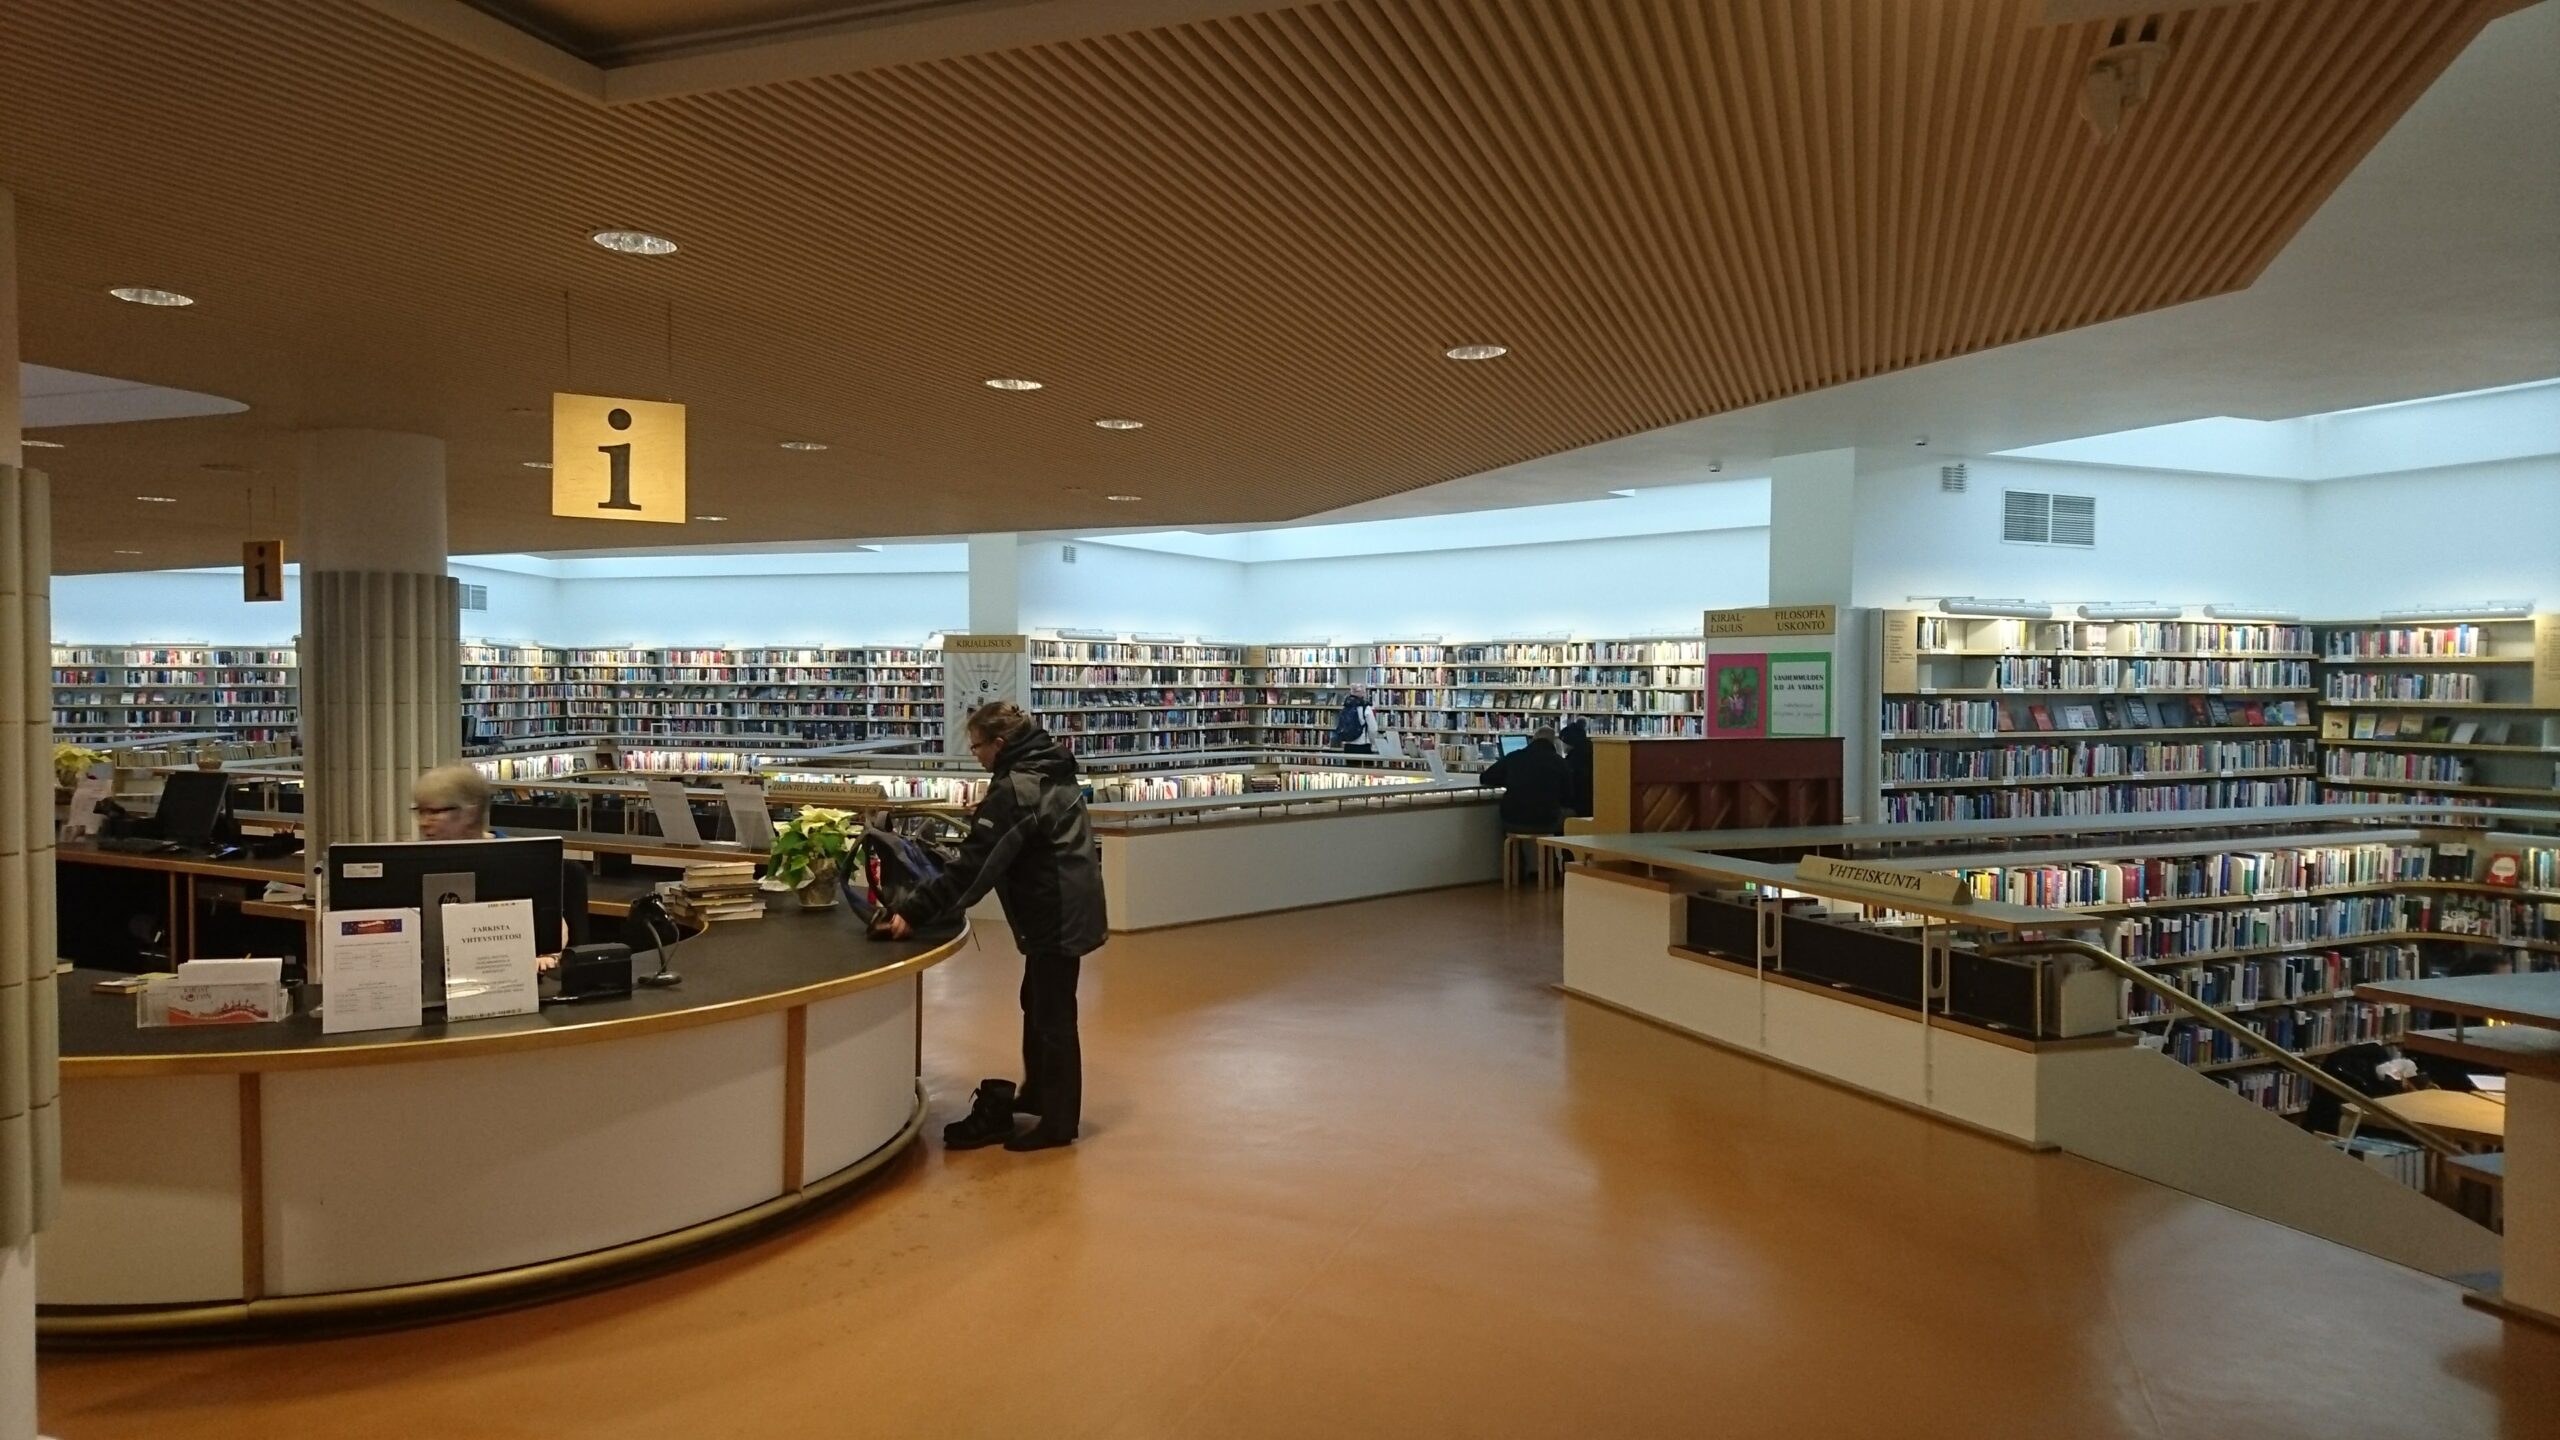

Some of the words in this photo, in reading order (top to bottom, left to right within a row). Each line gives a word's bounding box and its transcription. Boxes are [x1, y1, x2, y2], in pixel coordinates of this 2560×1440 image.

[1711, 613, 1746, 623] KIRJAL-
[1775, 610, 1826, 620] FILOSOFIA
[1710, 624, 1743, 633] LISUUS
[1777, 621, 1825, 631] USKONTO
[956, 639, 1012, 648] KIRJALLISUUS
[773, 783, 803, 792] LUONTO
[806, 784, 846, 793] TEKNIIKKA
[849, 785, 878, 794] TALOUS
[1828, 863, 1922, 891] YHTEISKUNTA
[472, 925, 511, 933] TARKISTA
[461, 934, 522, 944] YHTEYSTIETOSI
